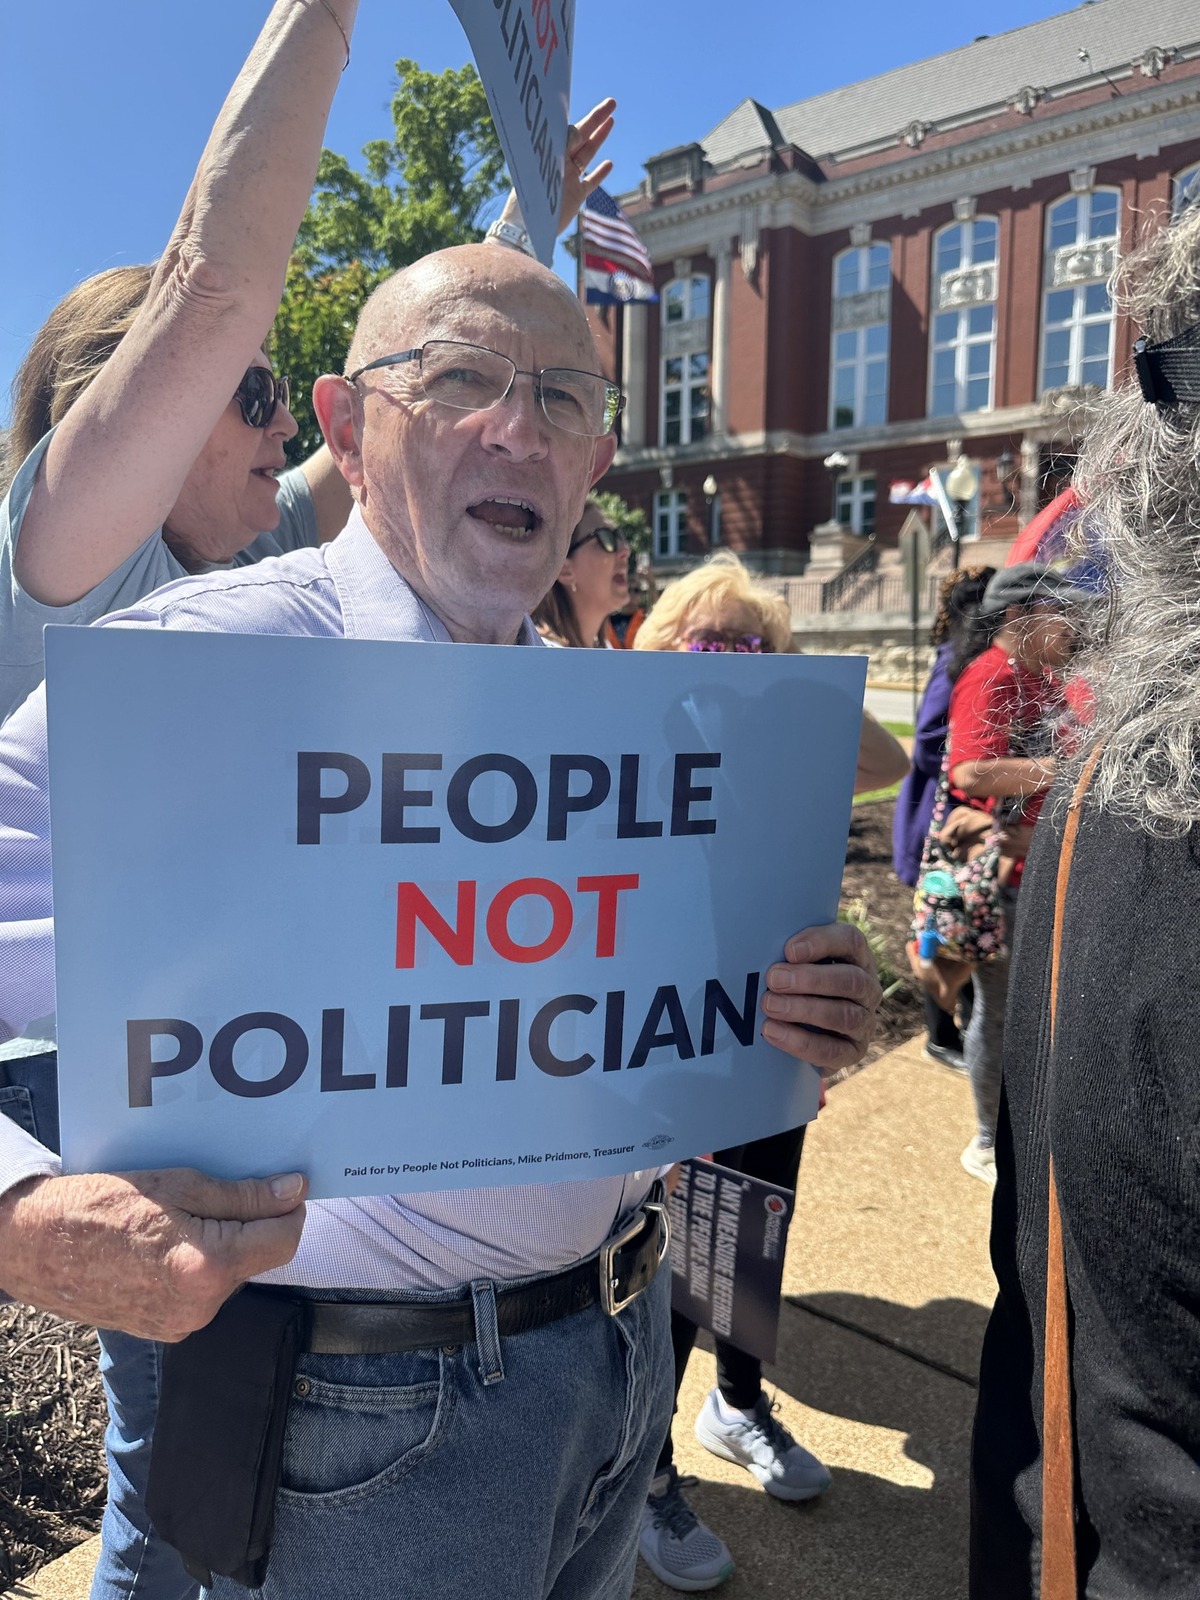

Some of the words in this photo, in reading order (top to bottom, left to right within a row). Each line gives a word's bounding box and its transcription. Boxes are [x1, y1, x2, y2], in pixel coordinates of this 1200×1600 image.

[492, 0, 561, 216] LITICIANS
[297, 752, 722, 845] PEOPLE
[396, 873, 639, 969] NOT
[127, 970, 763, 1108] POLITICIAN
[343, 1166, 368, 1177] Paid
[370, 1165, 386, 1176] for
[387, 1164, 401, 1175] by
[402, 1161, 439, 1173] People
[440, 1160, 460, 1170] Not
[462, 1157, 516, 1169] Politicians,
[518, 1153, 543, 1165] Mike
[545, 1149, 591, 1163] Pridmore,
[593, 1143, 636, 1157] Treasurer
[694, 1170, 717, 1192] TO
[692, 1188, 715, 1219] THE
[690, 1214, 713, 1267] PEOPLE
[714, 1208, 740, 1278] MEASURE
[690, 1260, 711, 1302] SHALL
[712, 1272, 734, 1337] REFERRED
